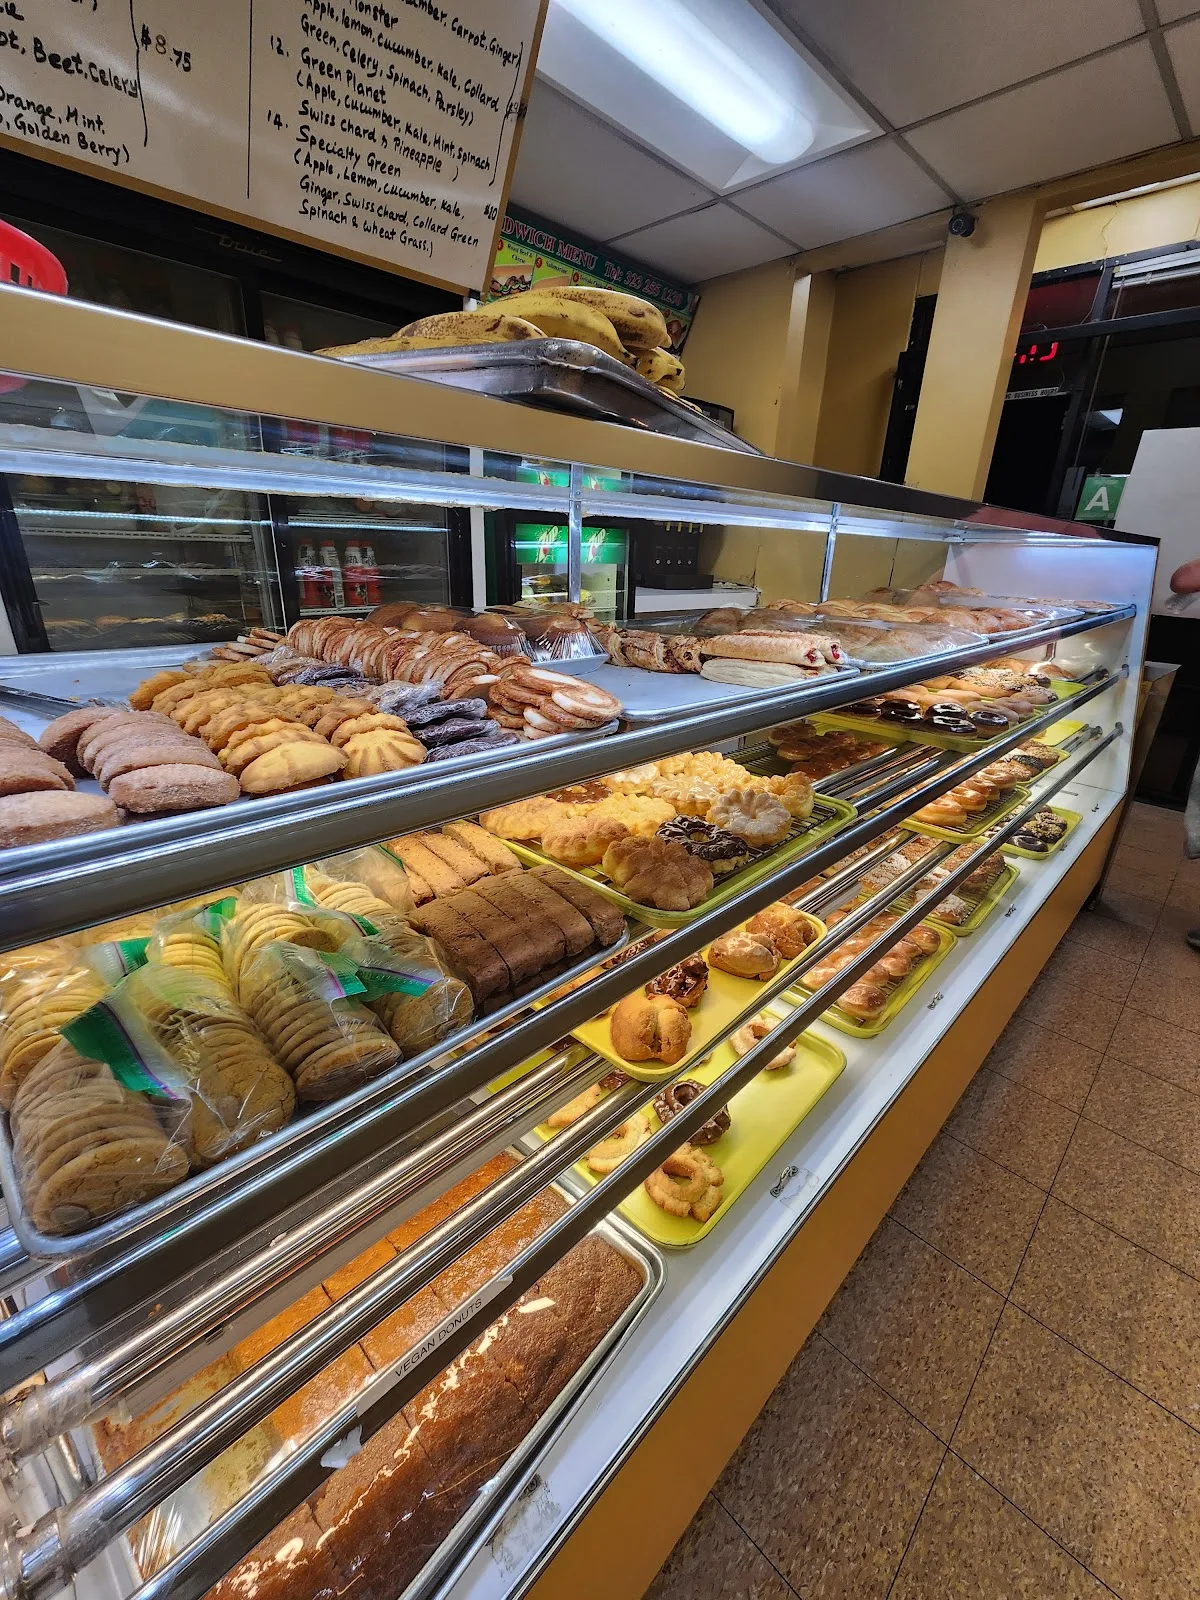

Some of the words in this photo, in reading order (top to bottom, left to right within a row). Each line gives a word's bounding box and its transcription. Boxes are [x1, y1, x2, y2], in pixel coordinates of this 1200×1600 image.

[140, 22, 192, 73] $8.75
[88, 62, 138, 98] Celery
[270, 34, 290, 57] 12.
[301, 46, 342, 82] Green
[345, 69, 387, 105] Planet
[464, 78, 500, 113] Collard
[14, 112, 70, 145] Golden
[77, 131, 130, 167] Berry)
[266, 109, 289, 131] 14.
[296, 124, 361, 170] Specialty
[366, 152, 401, 178] Green
[298, 99, 336, 127] Swiss
[340, 119, 378, 143] Chard
[393, 136, 443, 173] Pineapple
[457, 147, 491, 172] Spinach
[298, 198, 348, 224] Spinach
[343, 192, 375, 213] Swiss
[412, 215, 449, 236] Collard
[450, 226, 480, 248] Green
[483, 203, 498, 221] $10
[556, 239, 599, 271] MENU
[1083, 486, 1110, 511] A
[395, 1337, 436, 1378] VEGAN
[438, 1298, 482, 1341] DONUTS
